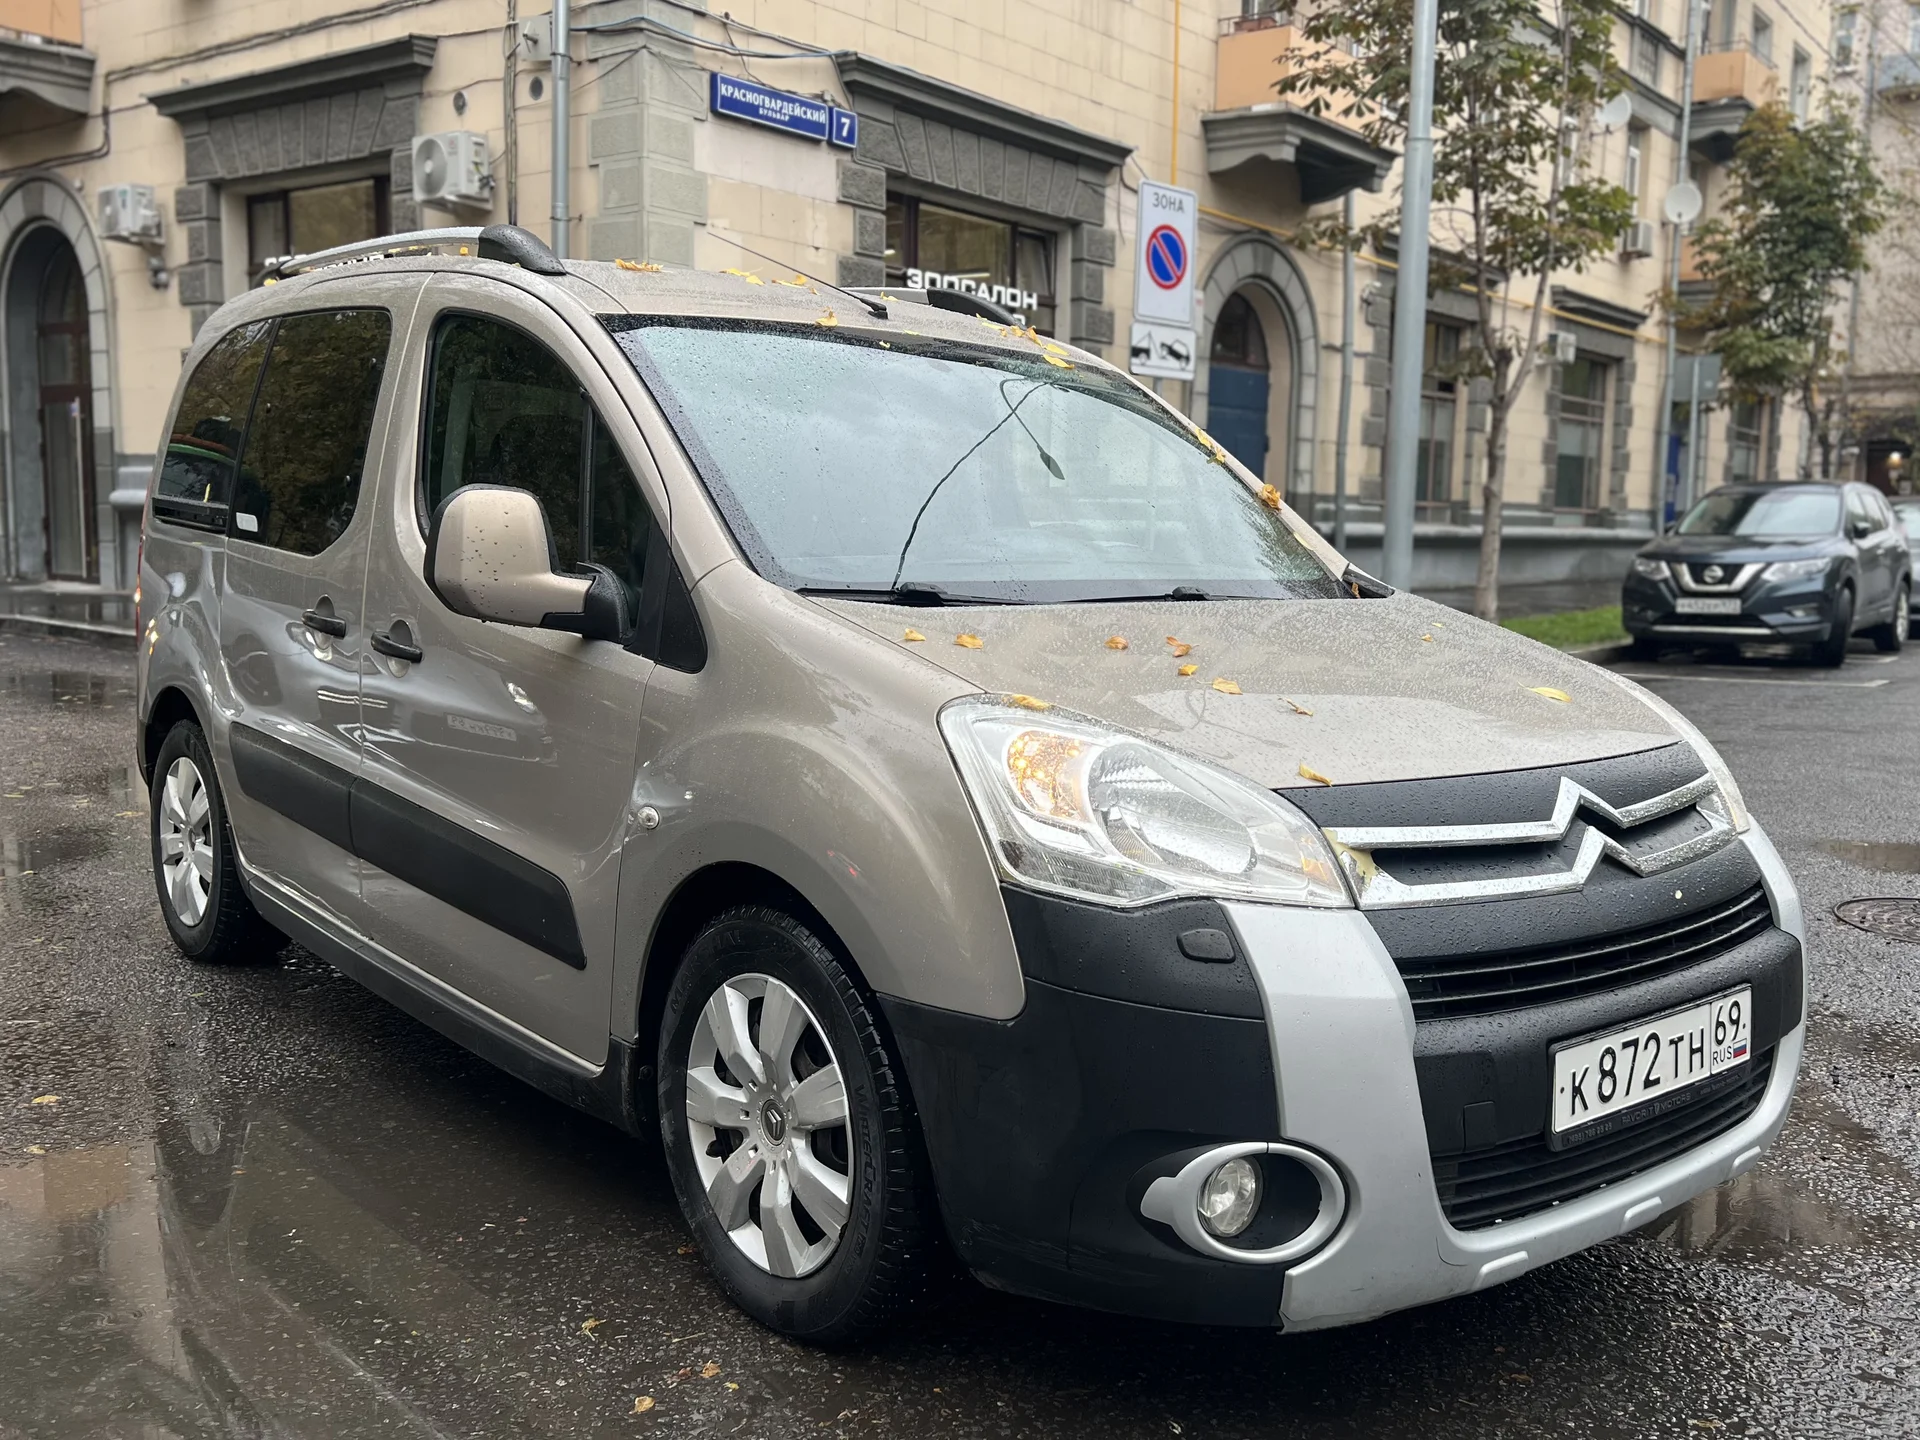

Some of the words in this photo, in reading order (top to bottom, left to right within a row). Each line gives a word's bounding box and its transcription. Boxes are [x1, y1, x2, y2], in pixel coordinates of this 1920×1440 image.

[720, 83, 826, 125] КРАСНОГВАРДЕЙСКИЙ
[758, 106, 790, 122] БУЛЬВАР
[840, 117, 850, 138] 7
[1152, 191, 1185, 214] ЗОНА
[1715, 1000, 1741, 1046] 69
[1712, 1045, 1733, 1066] RUS
